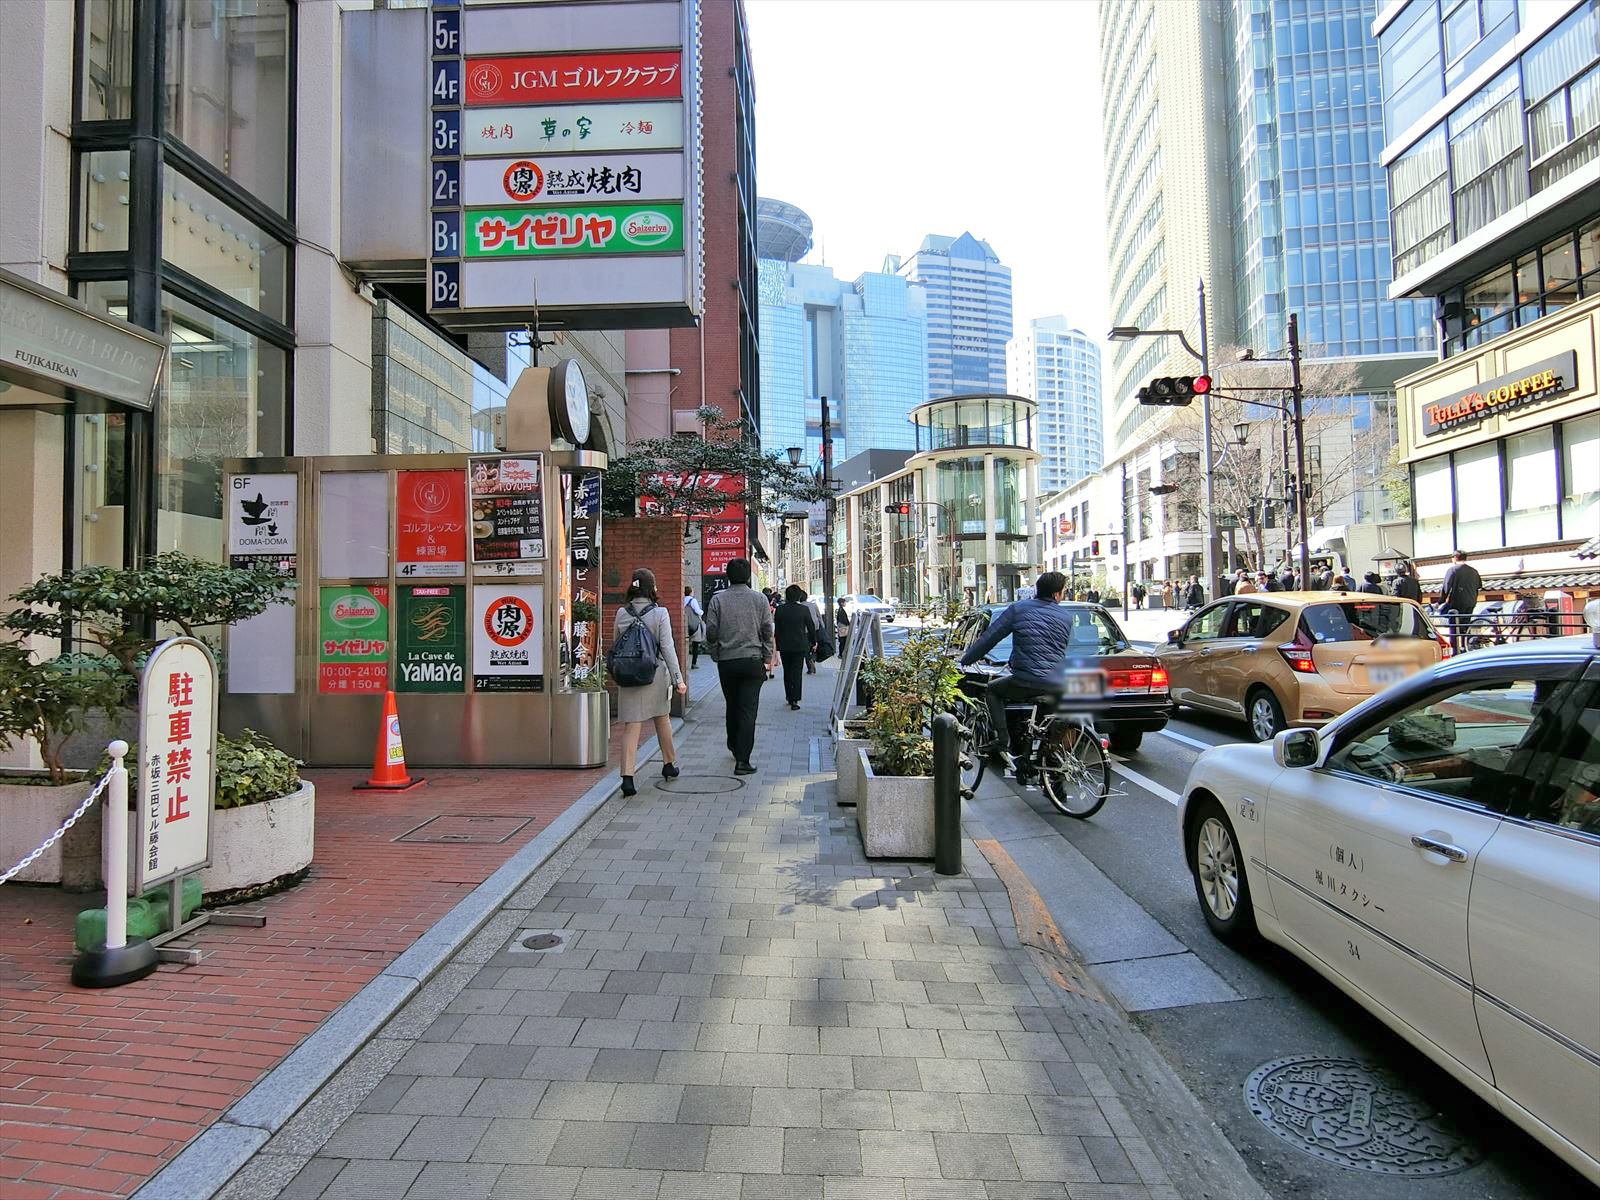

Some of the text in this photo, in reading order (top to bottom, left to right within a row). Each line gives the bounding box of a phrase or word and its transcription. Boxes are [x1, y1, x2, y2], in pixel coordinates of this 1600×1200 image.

[435, 19, 458, 50] 5F
[434, 69, 458, 100] 4F
[511, 70, 558, 90] JGM
[563, 63, 679, 88] ゴルフクラブ
[434, 119, 458, 150] 3F
[481, 116, 653, 142] 焼肉 草の家 冷麺
[434, 169, 458, 200] 2F
[513, 168, 533, 195] 肉源
[434, 219, 458, 251] B1
[476, 213, 615, 249] サイゼリヤ
[434, 269, 458, 302] B2
[508, 332, 518, 347] S
[15, 349, 79, 378] FUJIKAIKAN
[1424, 368, 1557, 427] TULLY'S COFFEE
[233, 477, 251, 489] 6F
[402, 522, 463, 533] ゴルフレッスン
[427, 534, 436, 544] &
[707, 536, 741, 545] BIG ECHO
[239, 538, 288, 546] DOMA-DOMA
[416, 546, 447, 556] 練習場
[573, 482, 590, 602] 赤坂三田ビル
[402, 564, 417, 575] 4F
[496, 605, 522, 637] 肉源
[323, 639, 385, 656] サイゼリヤ
[408, 651, 455, 661] La Cave de
[322, 666, 387, 676] 10:00-24:00
[401, 662, 463, 682] YaMaYa
[476, 680, 488, 688] 2F
[165, 672, 194, 824] 駐車禁止
[148, 755, 161, 871] 赤坂三田ビル藤会館
[1329, 845, 1364, 872] (個人)
[1347, 939, 1361, 961] 34
